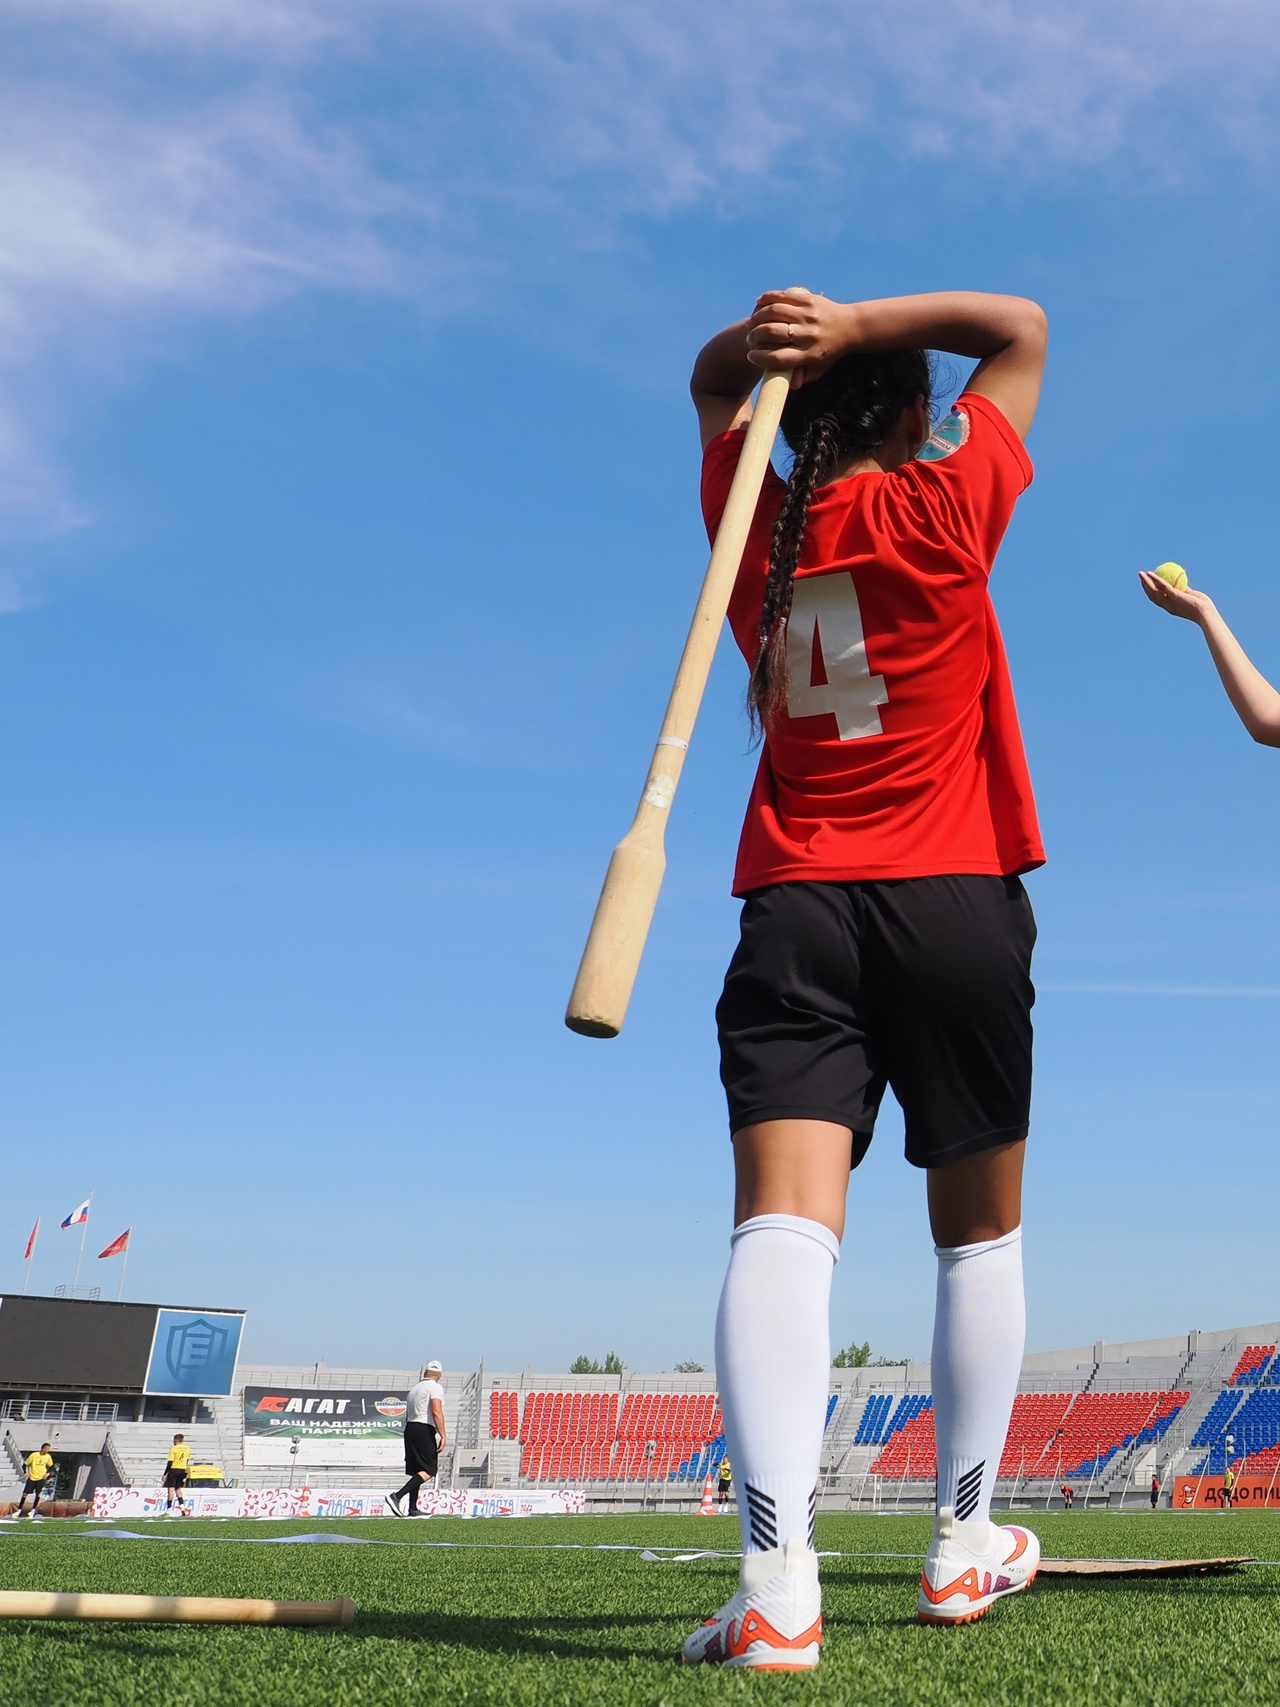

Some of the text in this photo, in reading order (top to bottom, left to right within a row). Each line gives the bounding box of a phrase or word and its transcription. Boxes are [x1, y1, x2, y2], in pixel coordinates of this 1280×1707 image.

[787, 571, 889, 742] 4
[284, 1397, 351, 1414] АГАТ
[269, 1419, 306, 1427] ВАШ
[301, 1427, 373, 1435] ПАРТНЕР
[202, 1504, 219, 1512] 2025
